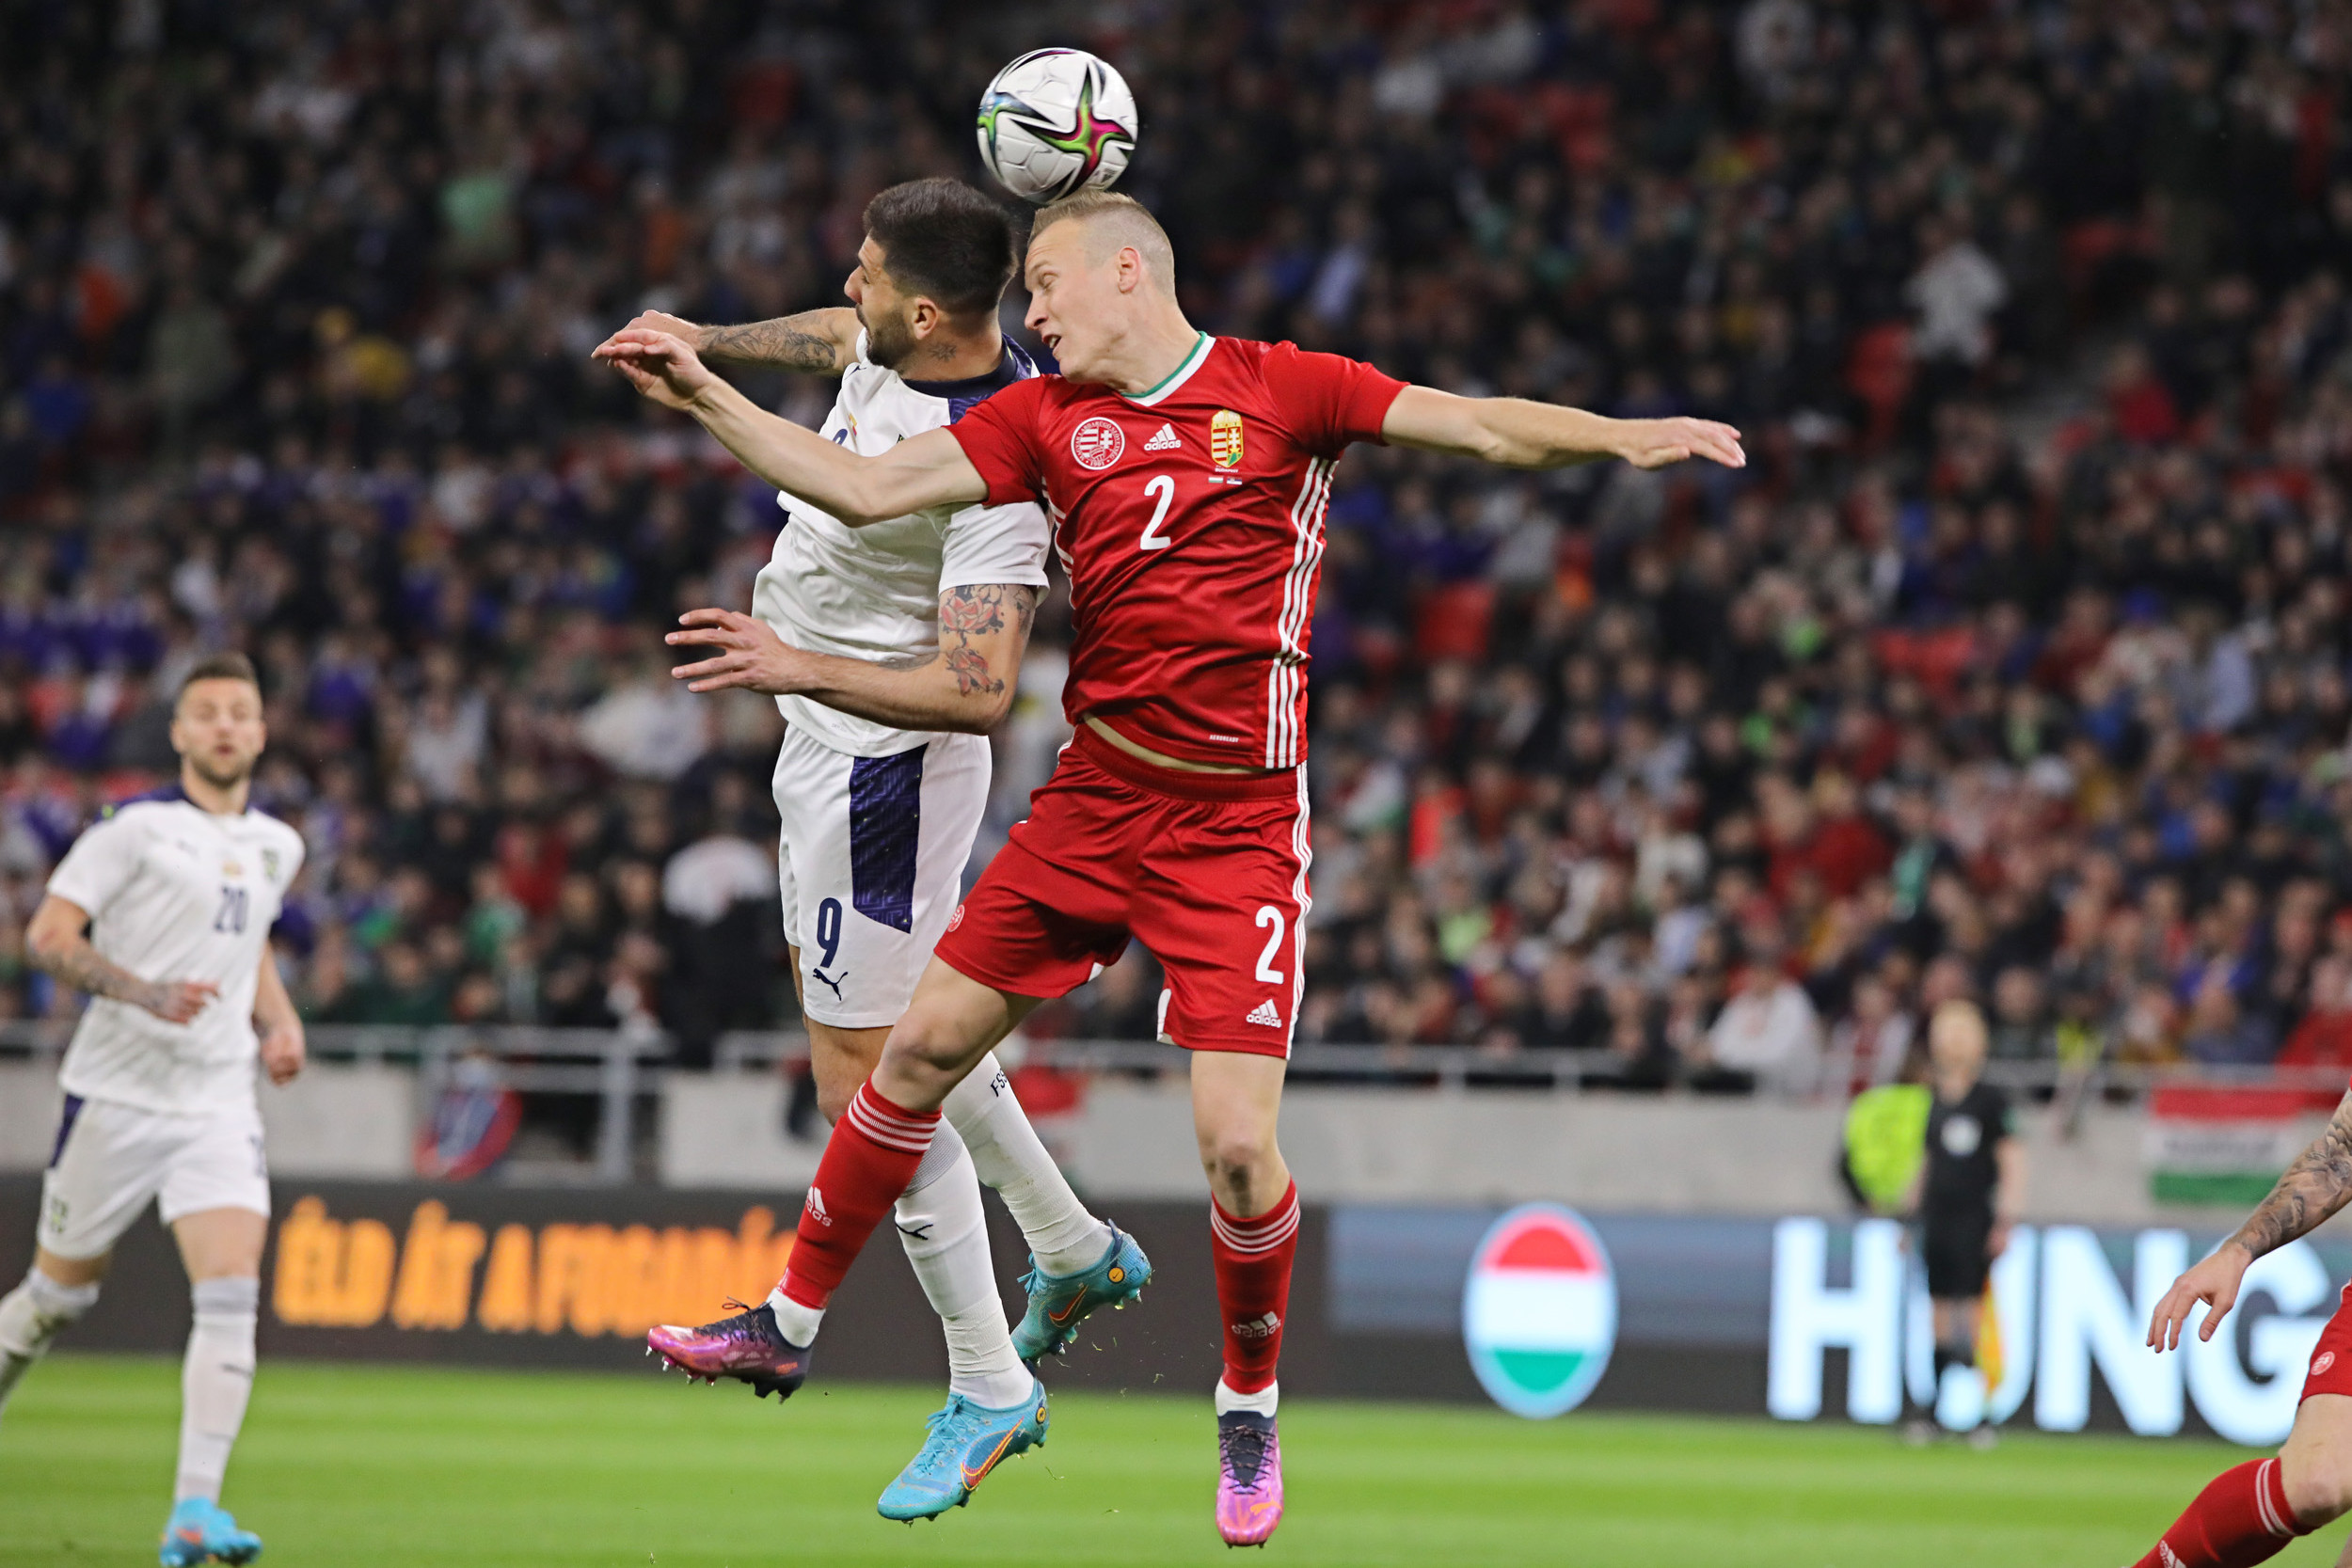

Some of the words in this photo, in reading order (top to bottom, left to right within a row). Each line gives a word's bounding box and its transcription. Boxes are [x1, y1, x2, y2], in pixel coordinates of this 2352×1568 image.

[1144, 439, 1182, 451] adidas
[1140, 474, 1175, 550] 2
[213, 884, 251, 934] 20
[817, 897, 842, 969] 9
[1255, 905, 1285, 985] 2
[1246, 1013, 1282, 1028] adidas
[273, 1196, 397, 1328] ÉLD
[477, 1222, 533, 1333] A
[1232, 1319, 1281, 1338] adidas
